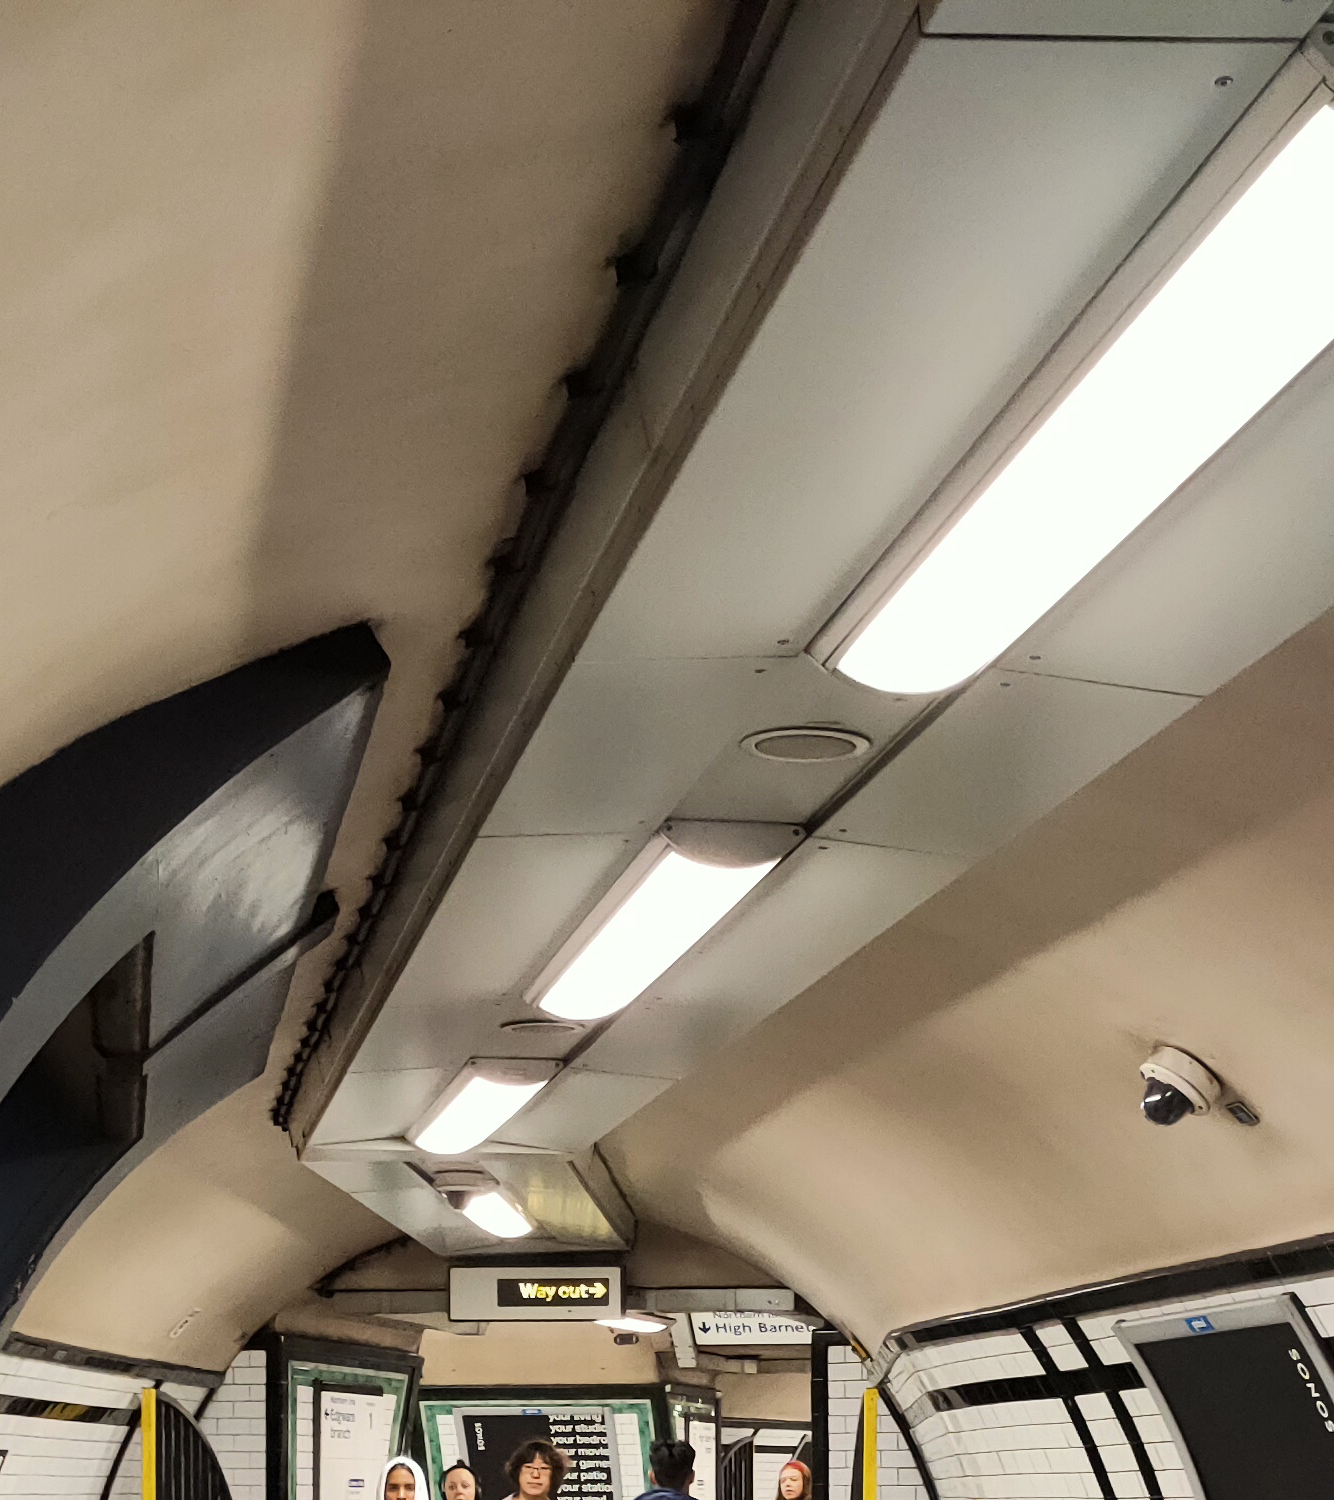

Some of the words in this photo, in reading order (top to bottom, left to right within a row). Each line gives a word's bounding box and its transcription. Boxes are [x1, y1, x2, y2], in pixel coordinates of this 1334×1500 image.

[518, 1282, 557, 1302] Way
[557, 1283, 590, 1299] out
[715, 1322, 752, 1336] High
[549, 1424, 573, 1434] your
[550, 1436, 575, 1445] your
